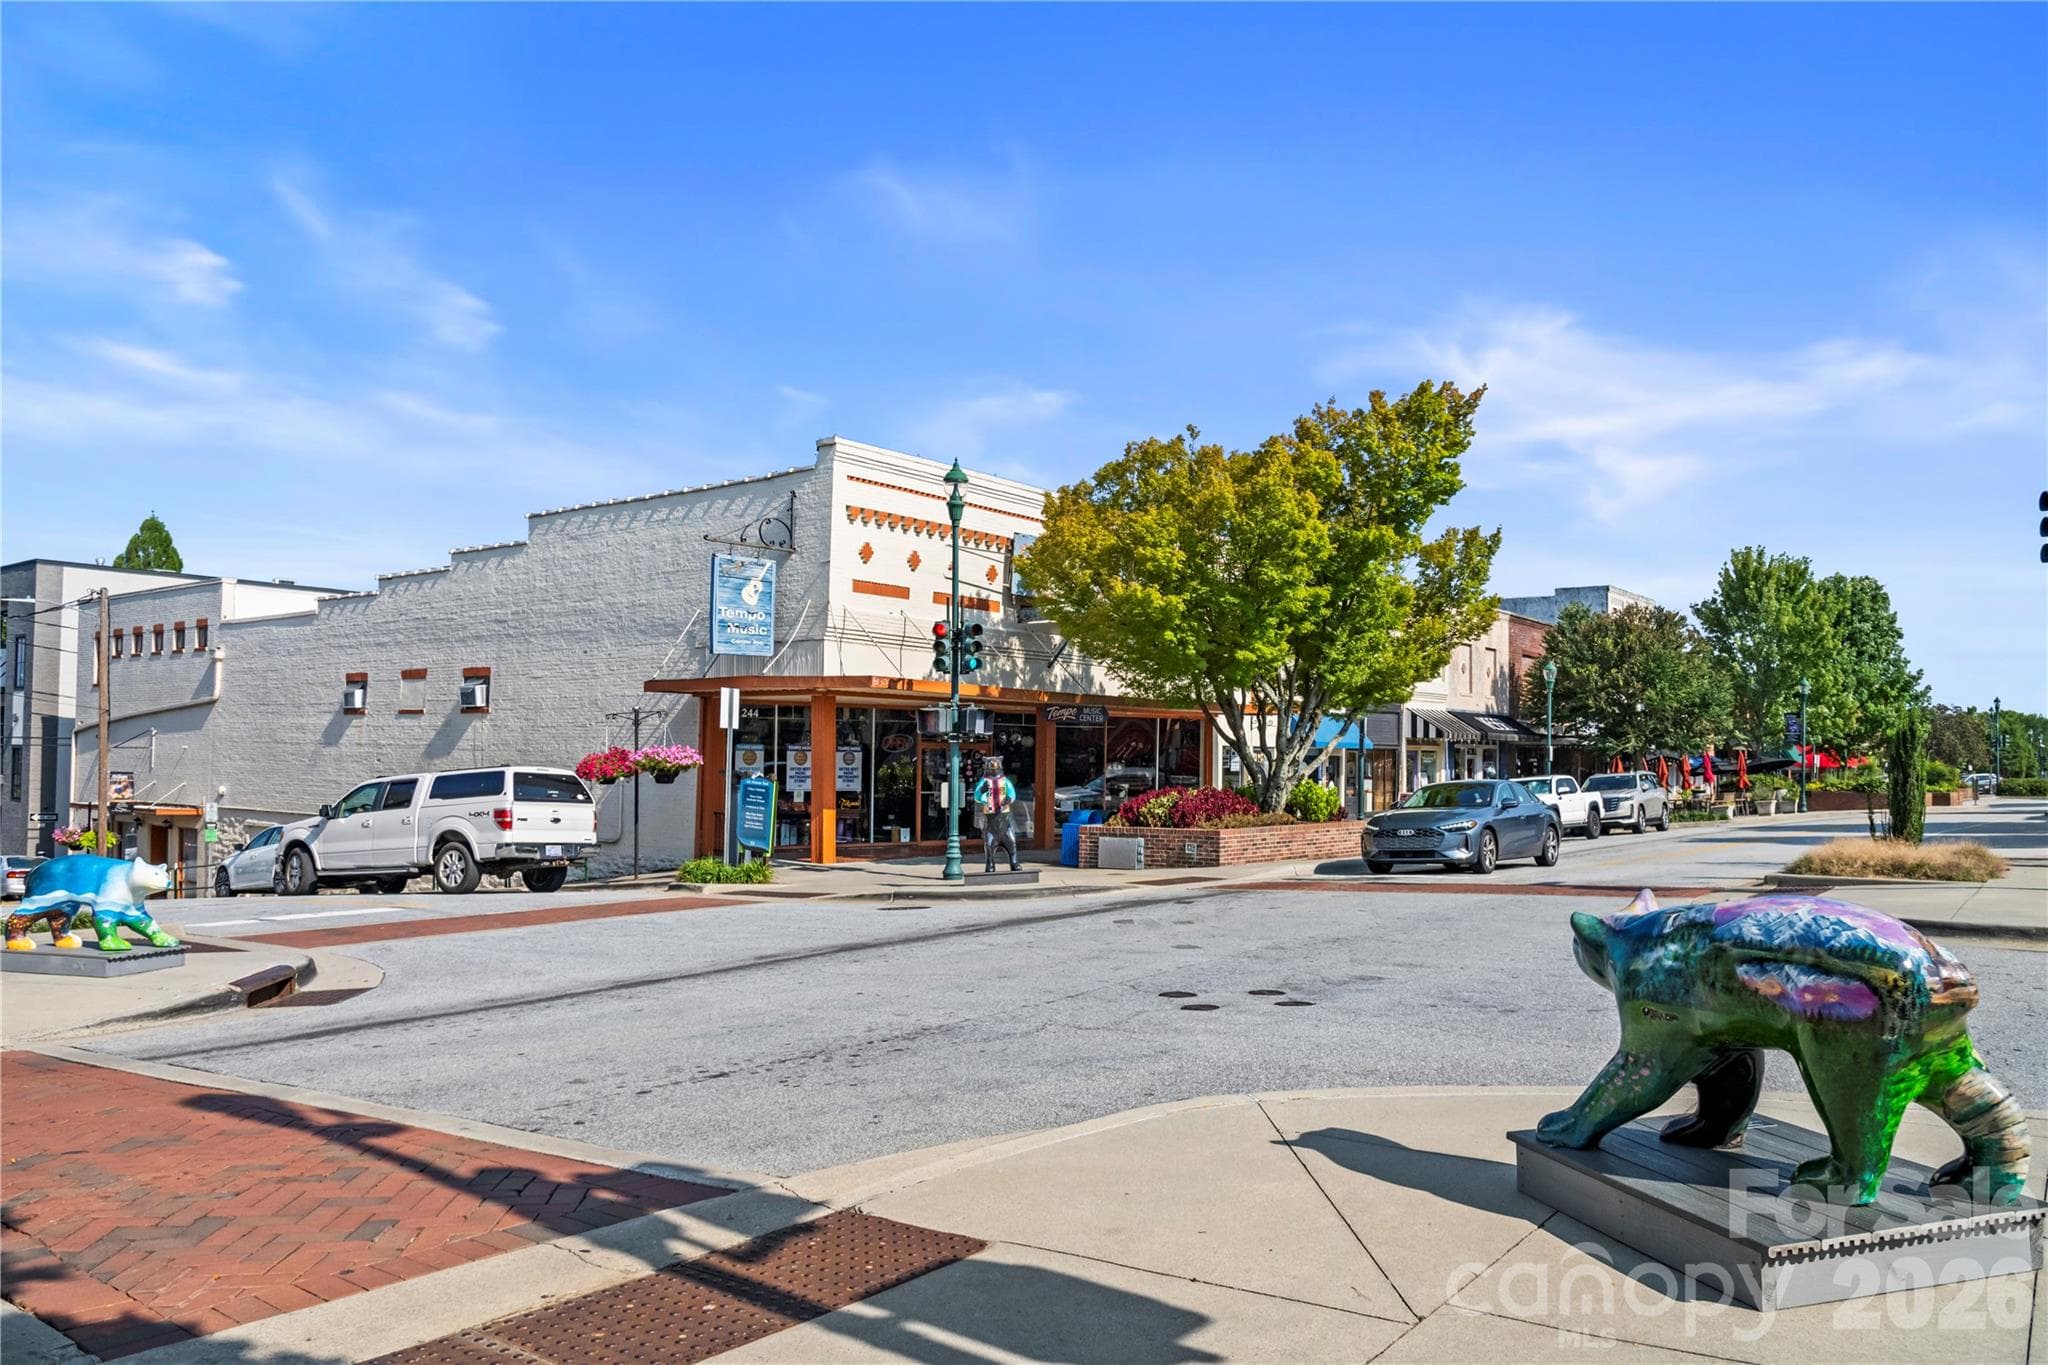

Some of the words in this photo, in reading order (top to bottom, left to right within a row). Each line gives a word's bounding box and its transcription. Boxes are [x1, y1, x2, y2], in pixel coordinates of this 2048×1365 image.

[718, 606, 766, 623] Tempo
[727, 622, 768, 636] Music
[741, 708, 759, 718] 244
[1046, 706, 1078, 721] Tempo
[1079, 714, 1104, 722] CENTER
